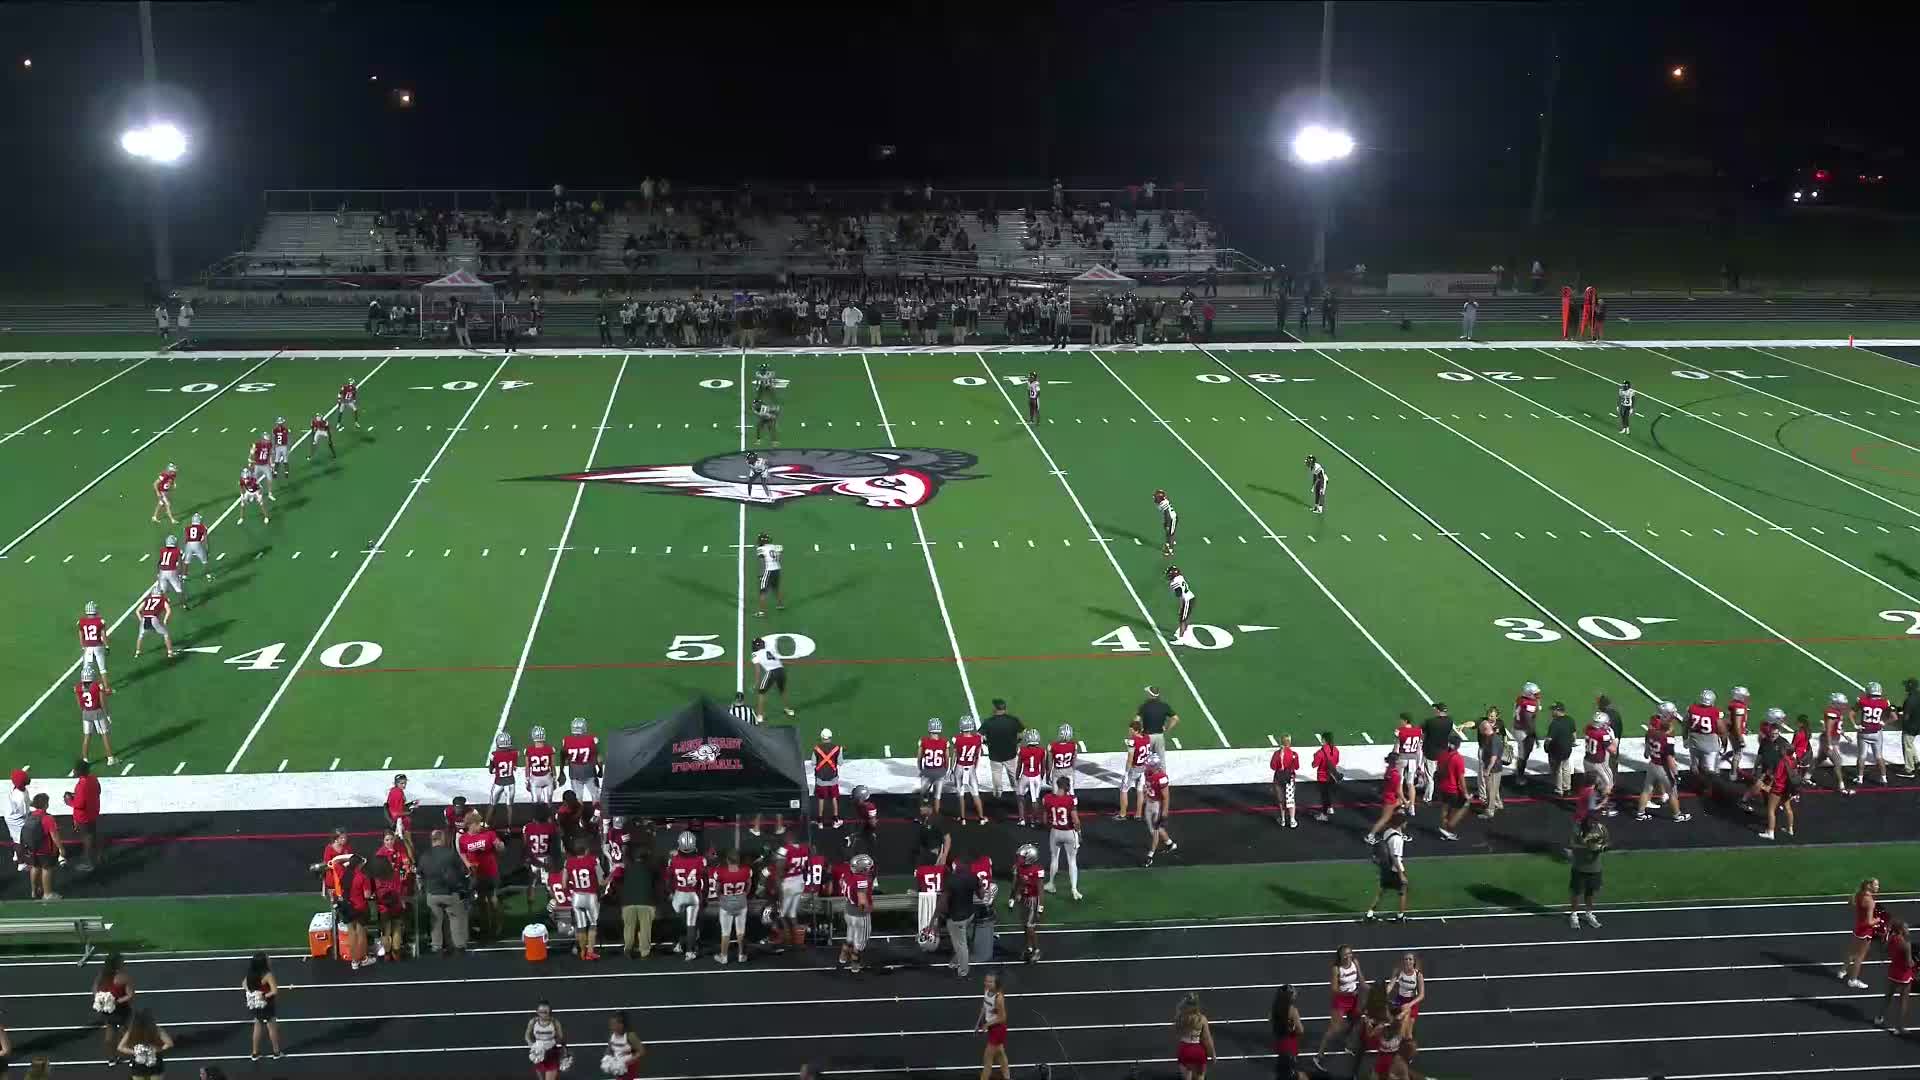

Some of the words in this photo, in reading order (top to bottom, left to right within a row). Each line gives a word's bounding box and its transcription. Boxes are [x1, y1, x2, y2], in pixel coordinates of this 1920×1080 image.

[190, 527, 198, 539] 8
[161, 551, 172, 566] 11
[144, 598, 161, 611] 17
[83, 624, 98, 641] 12
[1091, 623, 1235, 652] 40
[1493, 615, 1642, 643] 30
[224, 640, 383, 671] 40
[665, 632, 816, 662] 50
[82, 691, 93, 708] 3
[1862, 706, 1883, 723] 29
[1692, 714, 1713, 734] 79
[1403, 736, 1420, 753] 40
[567, 747, 590, 763] 77
[924, 749, 943, 767] 26
[960, 745, 976, 762] 14
[1055, 752, 1073, 768] 32
[498, 760, 513, 778] 21
[530, 755, 550, 772] 23
[1029, 756, 1035, 772] 1
[1051, 807, 1068, 826] 13
[530, 834, 549, 853] 35
[572, 868, 591, 889] 18
[674, 868, 697, 888] 54
[924, 873, 941, 893] 51
